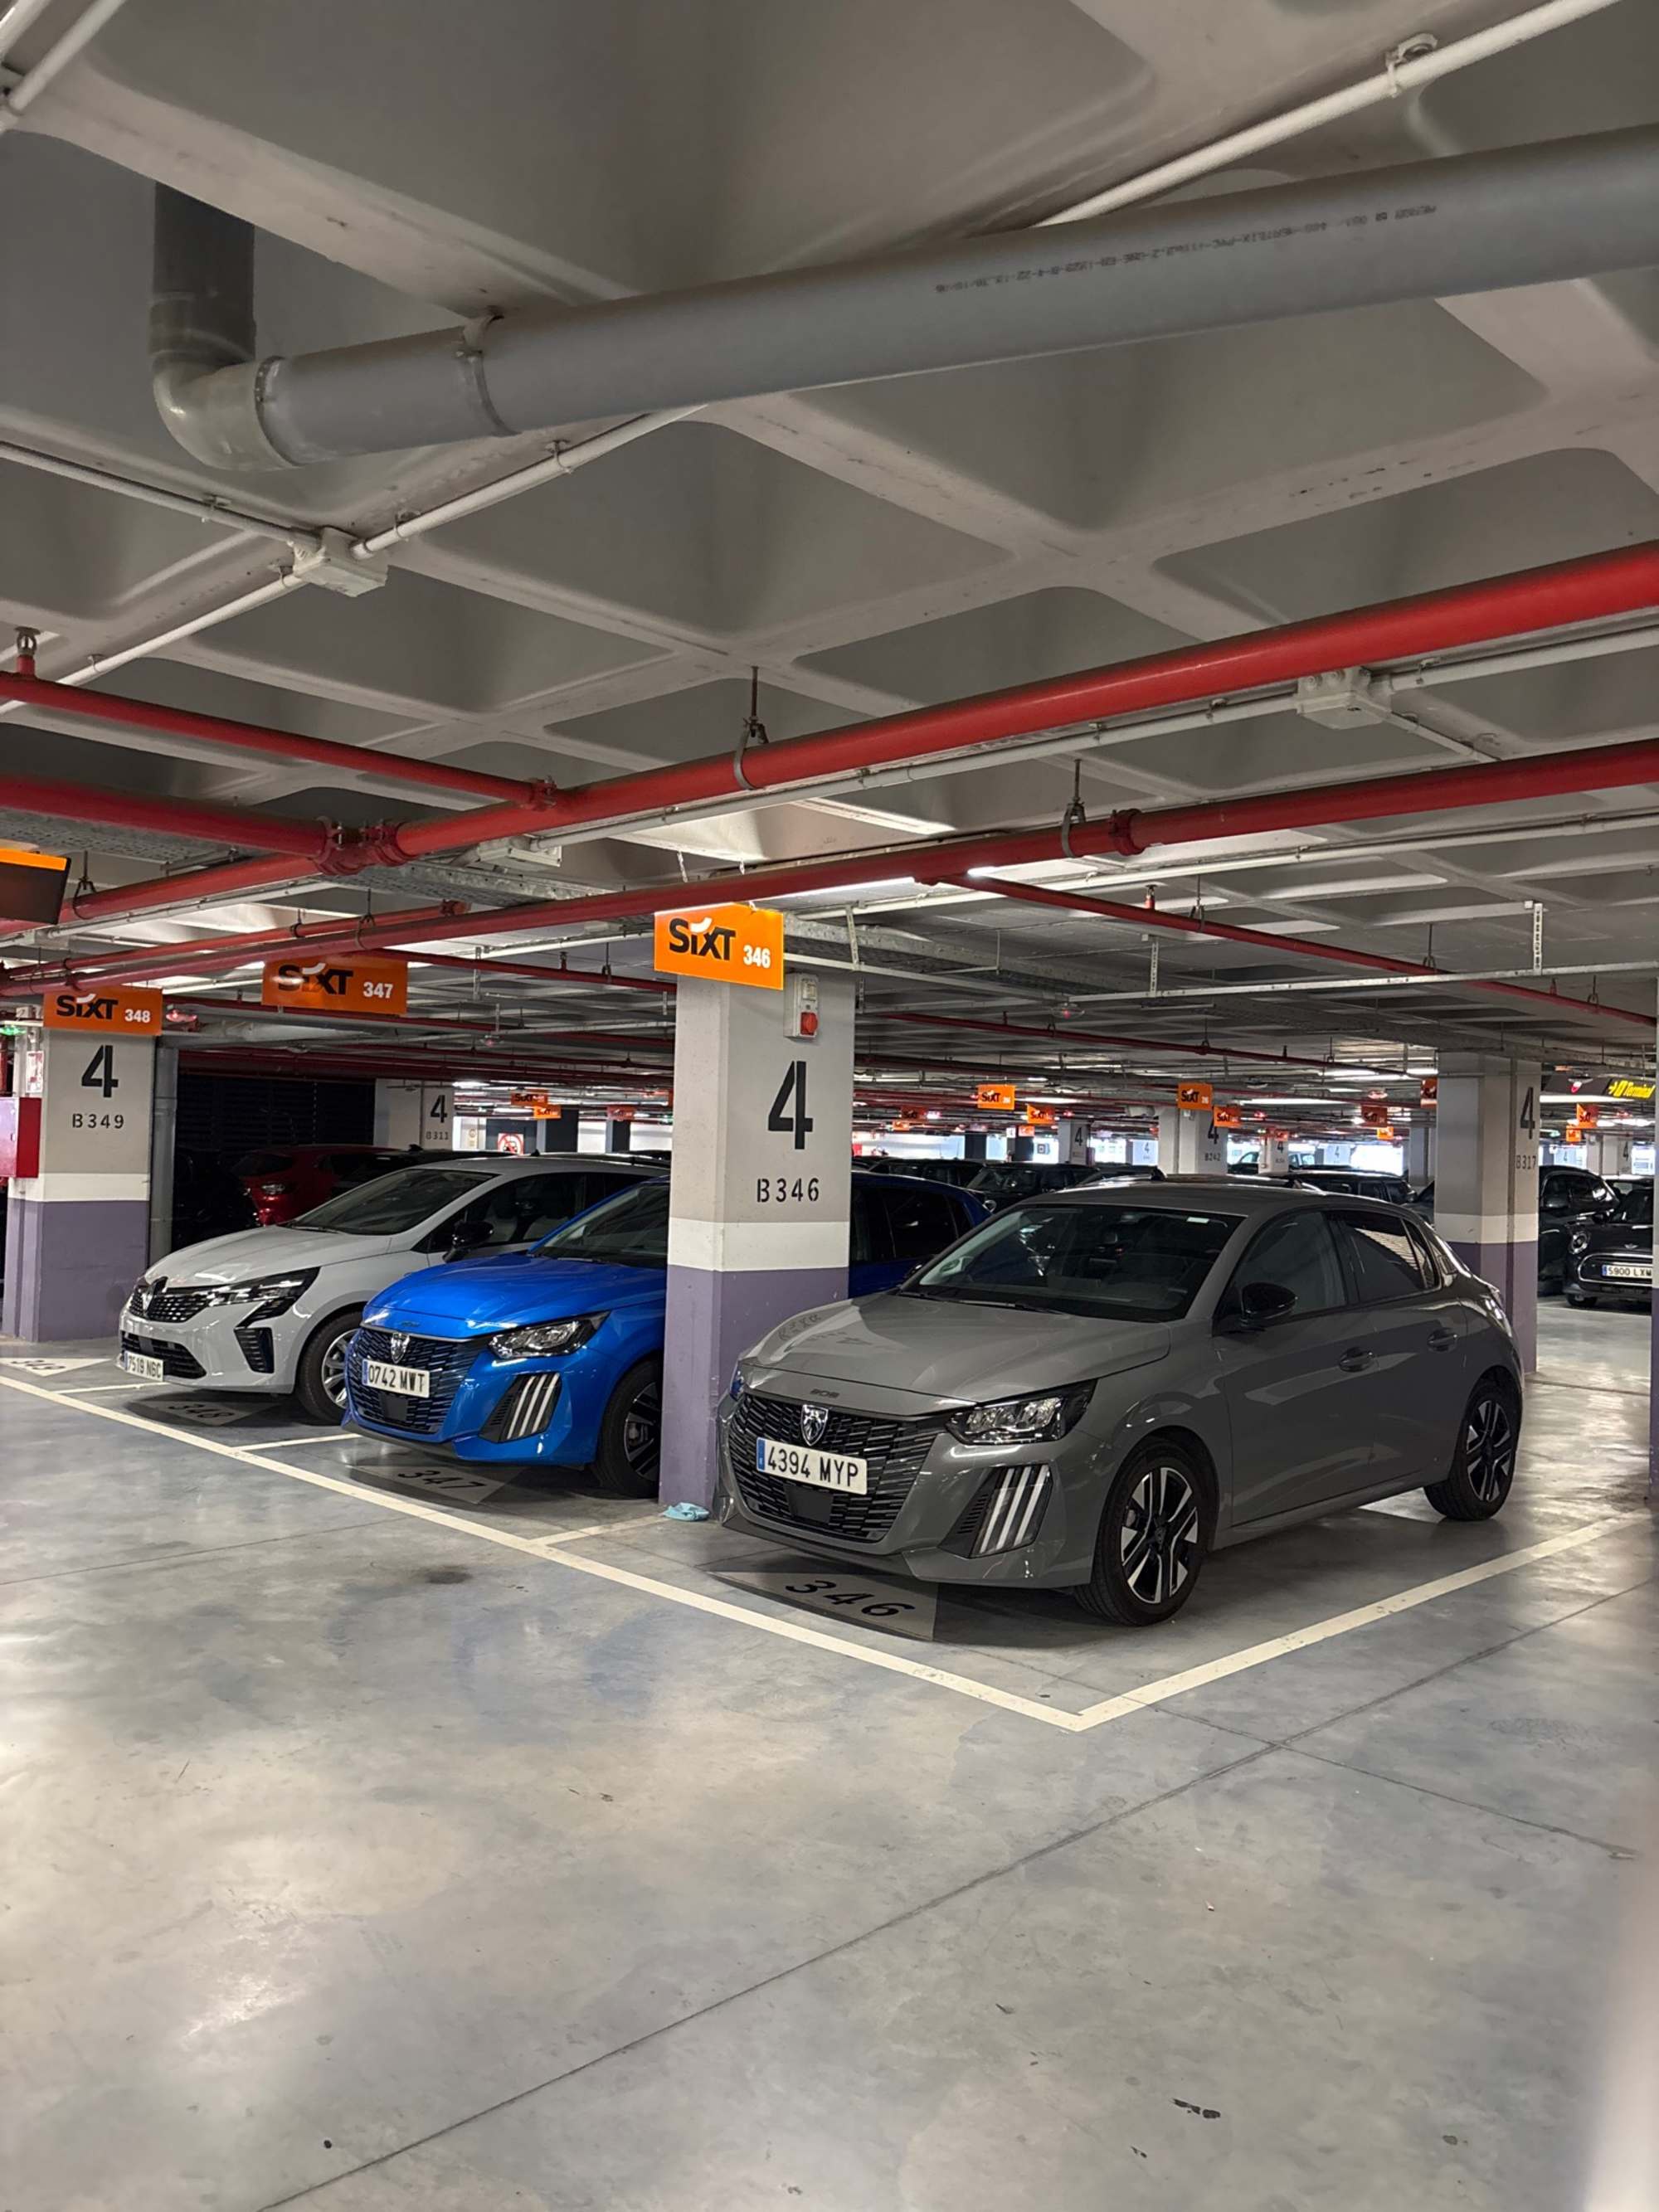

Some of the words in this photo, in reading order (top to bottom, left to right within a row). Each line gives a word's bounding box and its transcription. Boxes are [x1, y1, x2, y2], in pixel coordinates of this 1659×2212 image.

[742, 944, 771, 970] 346
[362, 981, 394, 999] 347
[124, 1009, 152, 1024] 348
[80, 1044, 119, 1099] 4
[430, 1094, 448, 1124] 4
[767, 1060, 814, 1150] 4
[1520, 1086, 1535, 1140] 4
[71, 1113, 125, 1130] B349
[1207, 1113, 1219, 1145] 4
[1074, 1126, 1083, 1147] 4
[1277, 1140, 1284, 1154] 4
[1623, 1141, 1629, 1163] 4
[756, 1177, 820, 1203] B346
[1608, 1267, 1631, 1276] 5900
[128, 1355, 144, 1374] 7519
[368, 1364, 397, 1388] 0742
[400, 1370, 425, 1393] MWT
[767, 1446, 811, 1479] 4394
[819, 1456, 859, 1487] MYP
[397, 1470, 487, 1490] 347
[785, 1579, 916, 1617] 346
